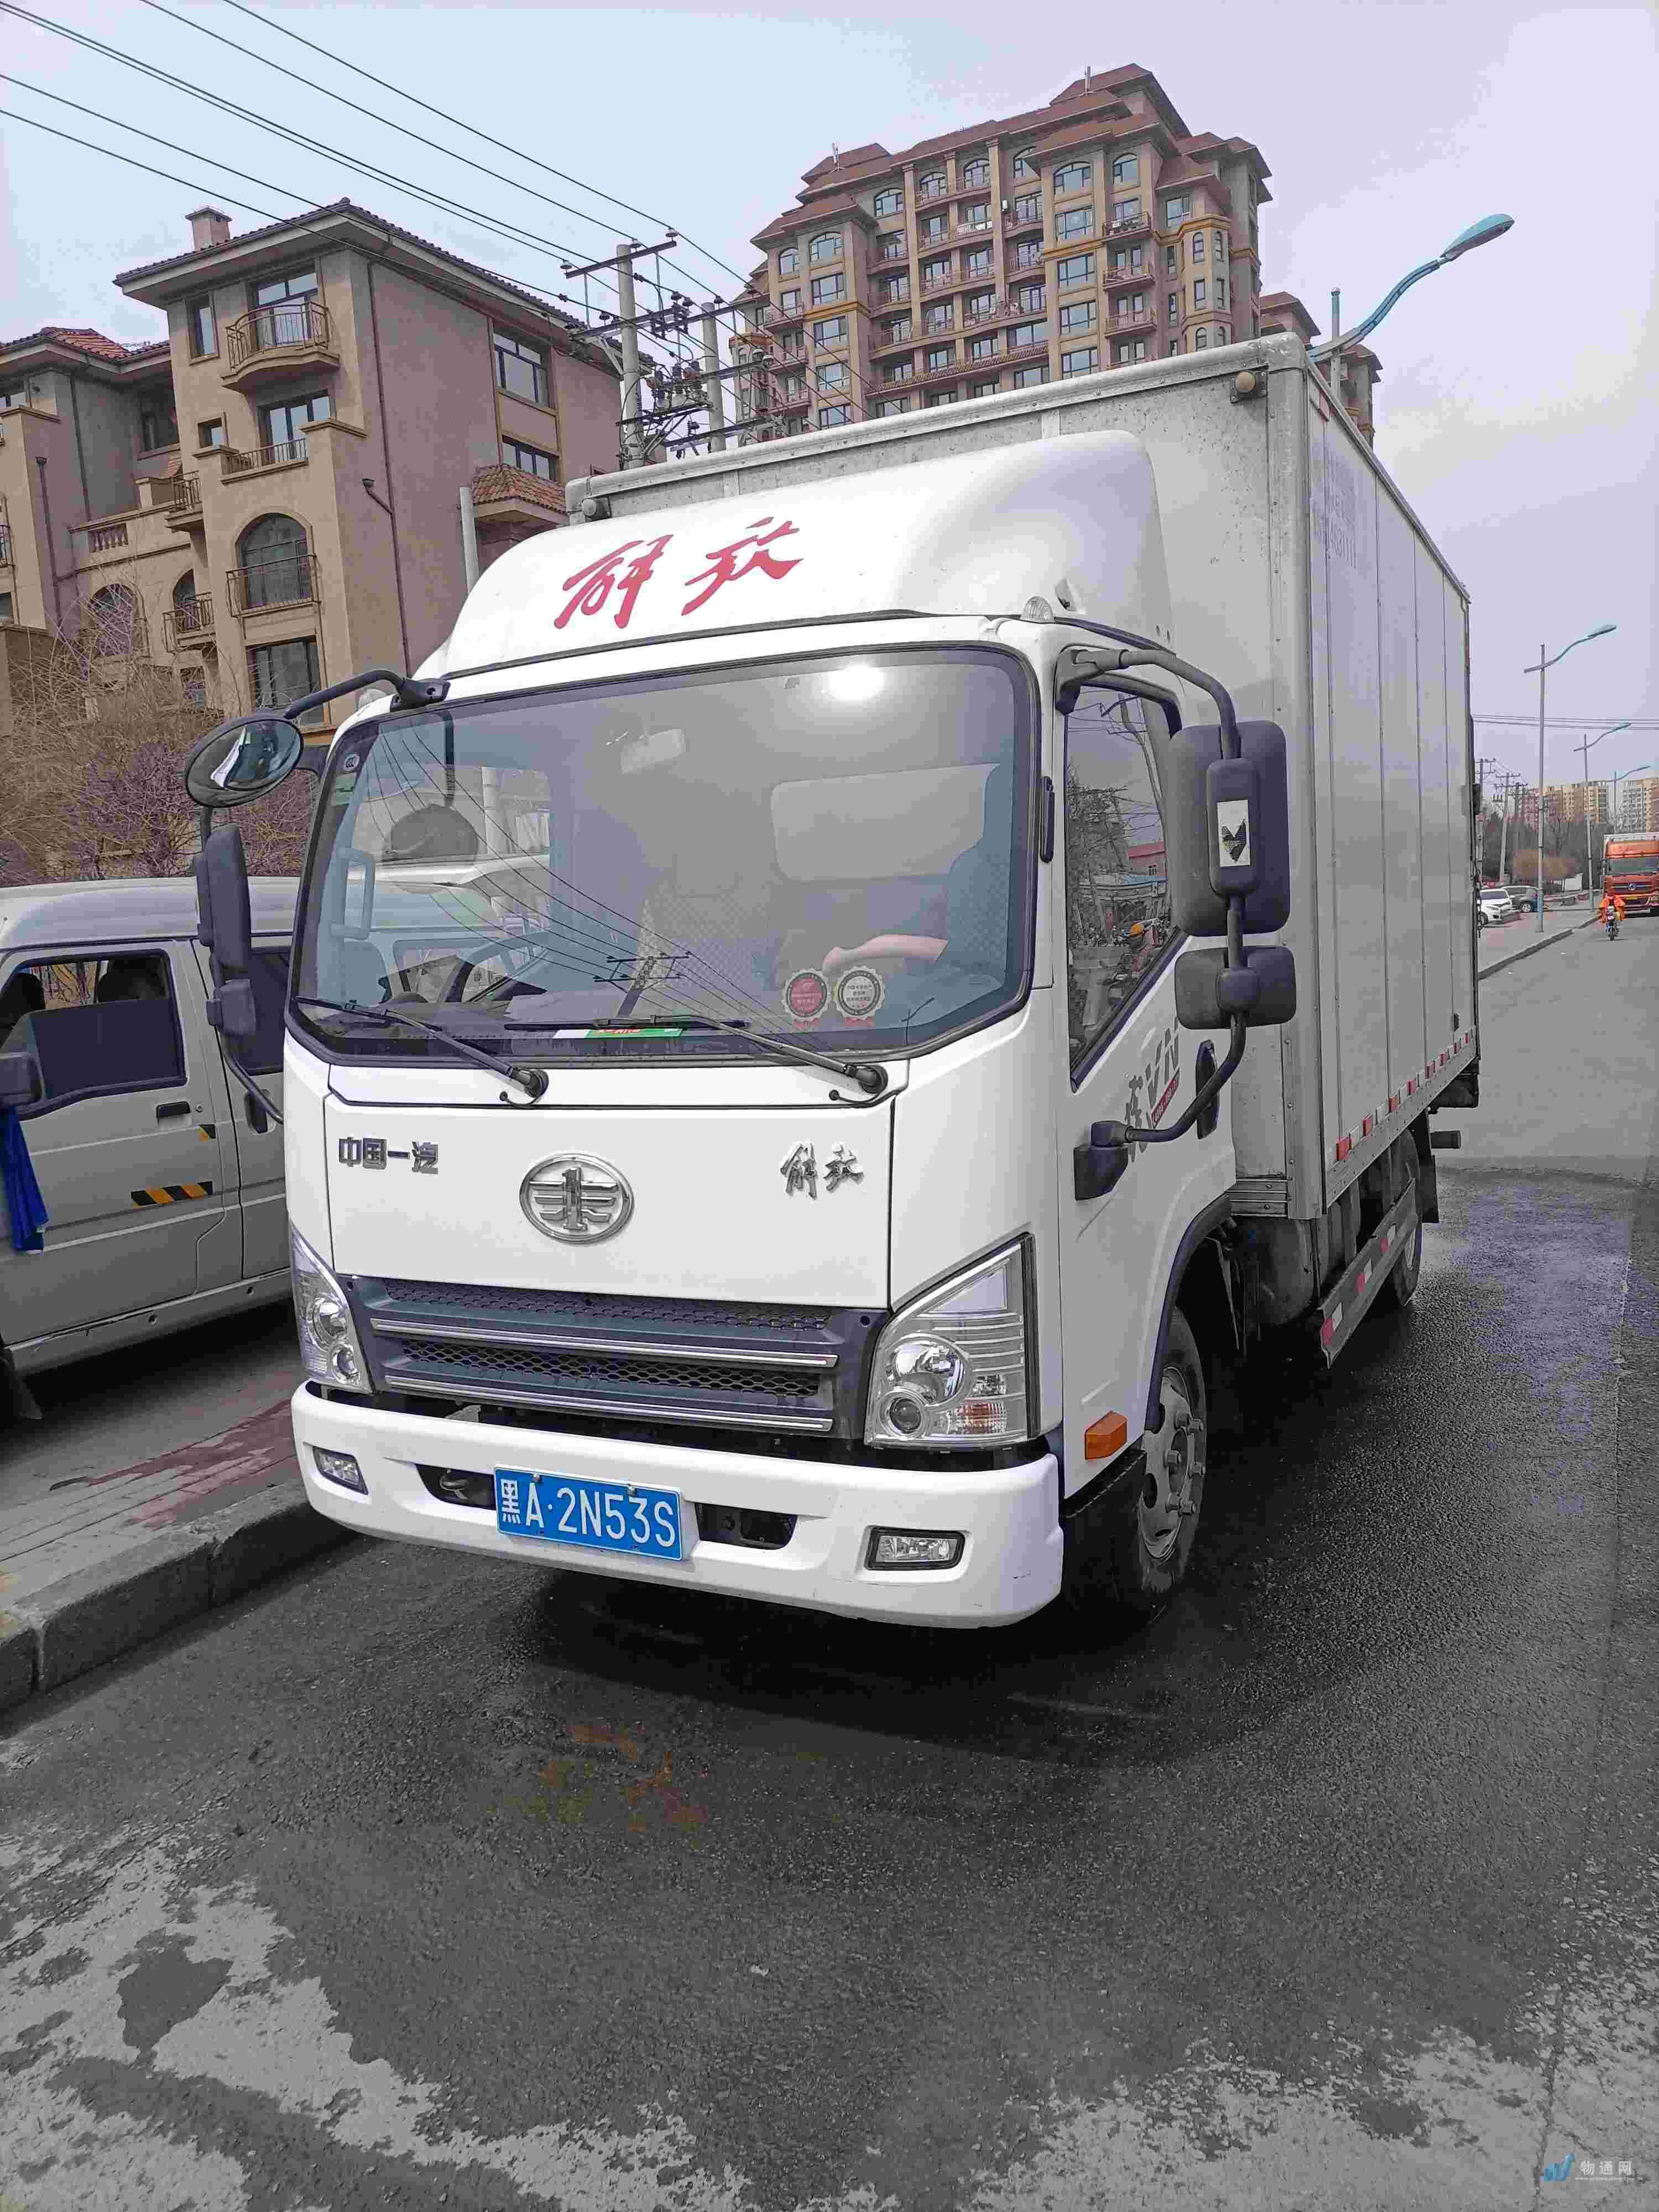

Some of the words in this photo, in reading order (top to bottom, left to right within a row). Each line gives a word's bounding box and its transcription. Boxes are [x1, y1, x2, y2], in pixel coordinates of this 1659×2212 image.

[554, 517, 804, 629] 解放
[338, 1137, 439, 1174] 中国一汽
[780, 1141, 864, 1200] 解放
[500, 1479, 676, 1547] 黑A·2N53S
